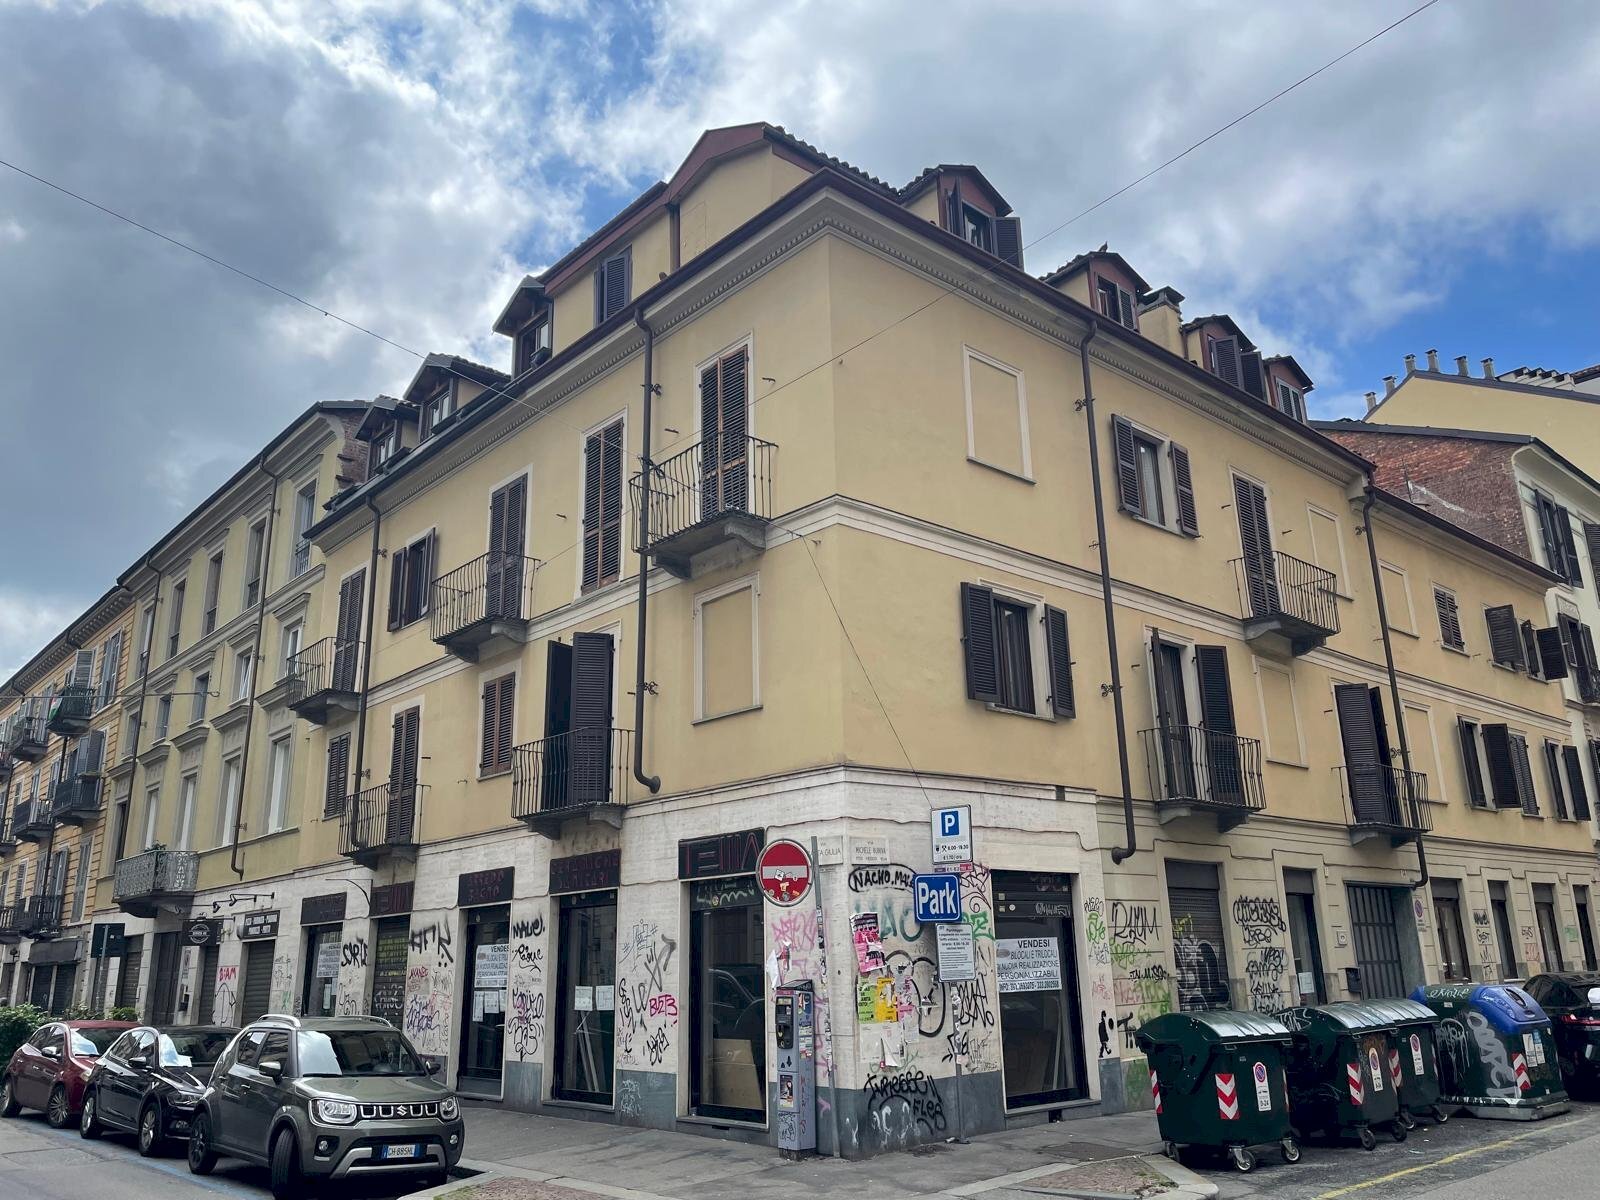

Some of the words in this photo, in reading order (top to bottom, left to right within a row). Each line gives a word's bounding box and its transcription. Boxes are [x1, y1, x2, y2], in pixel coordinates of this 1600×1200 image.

[944, 814, 955, 834] P
[918, 881, 957, 915] Park
[488, 944, 510, 953] VENDES
[1017, 939, 1050, 948] VENDESI
